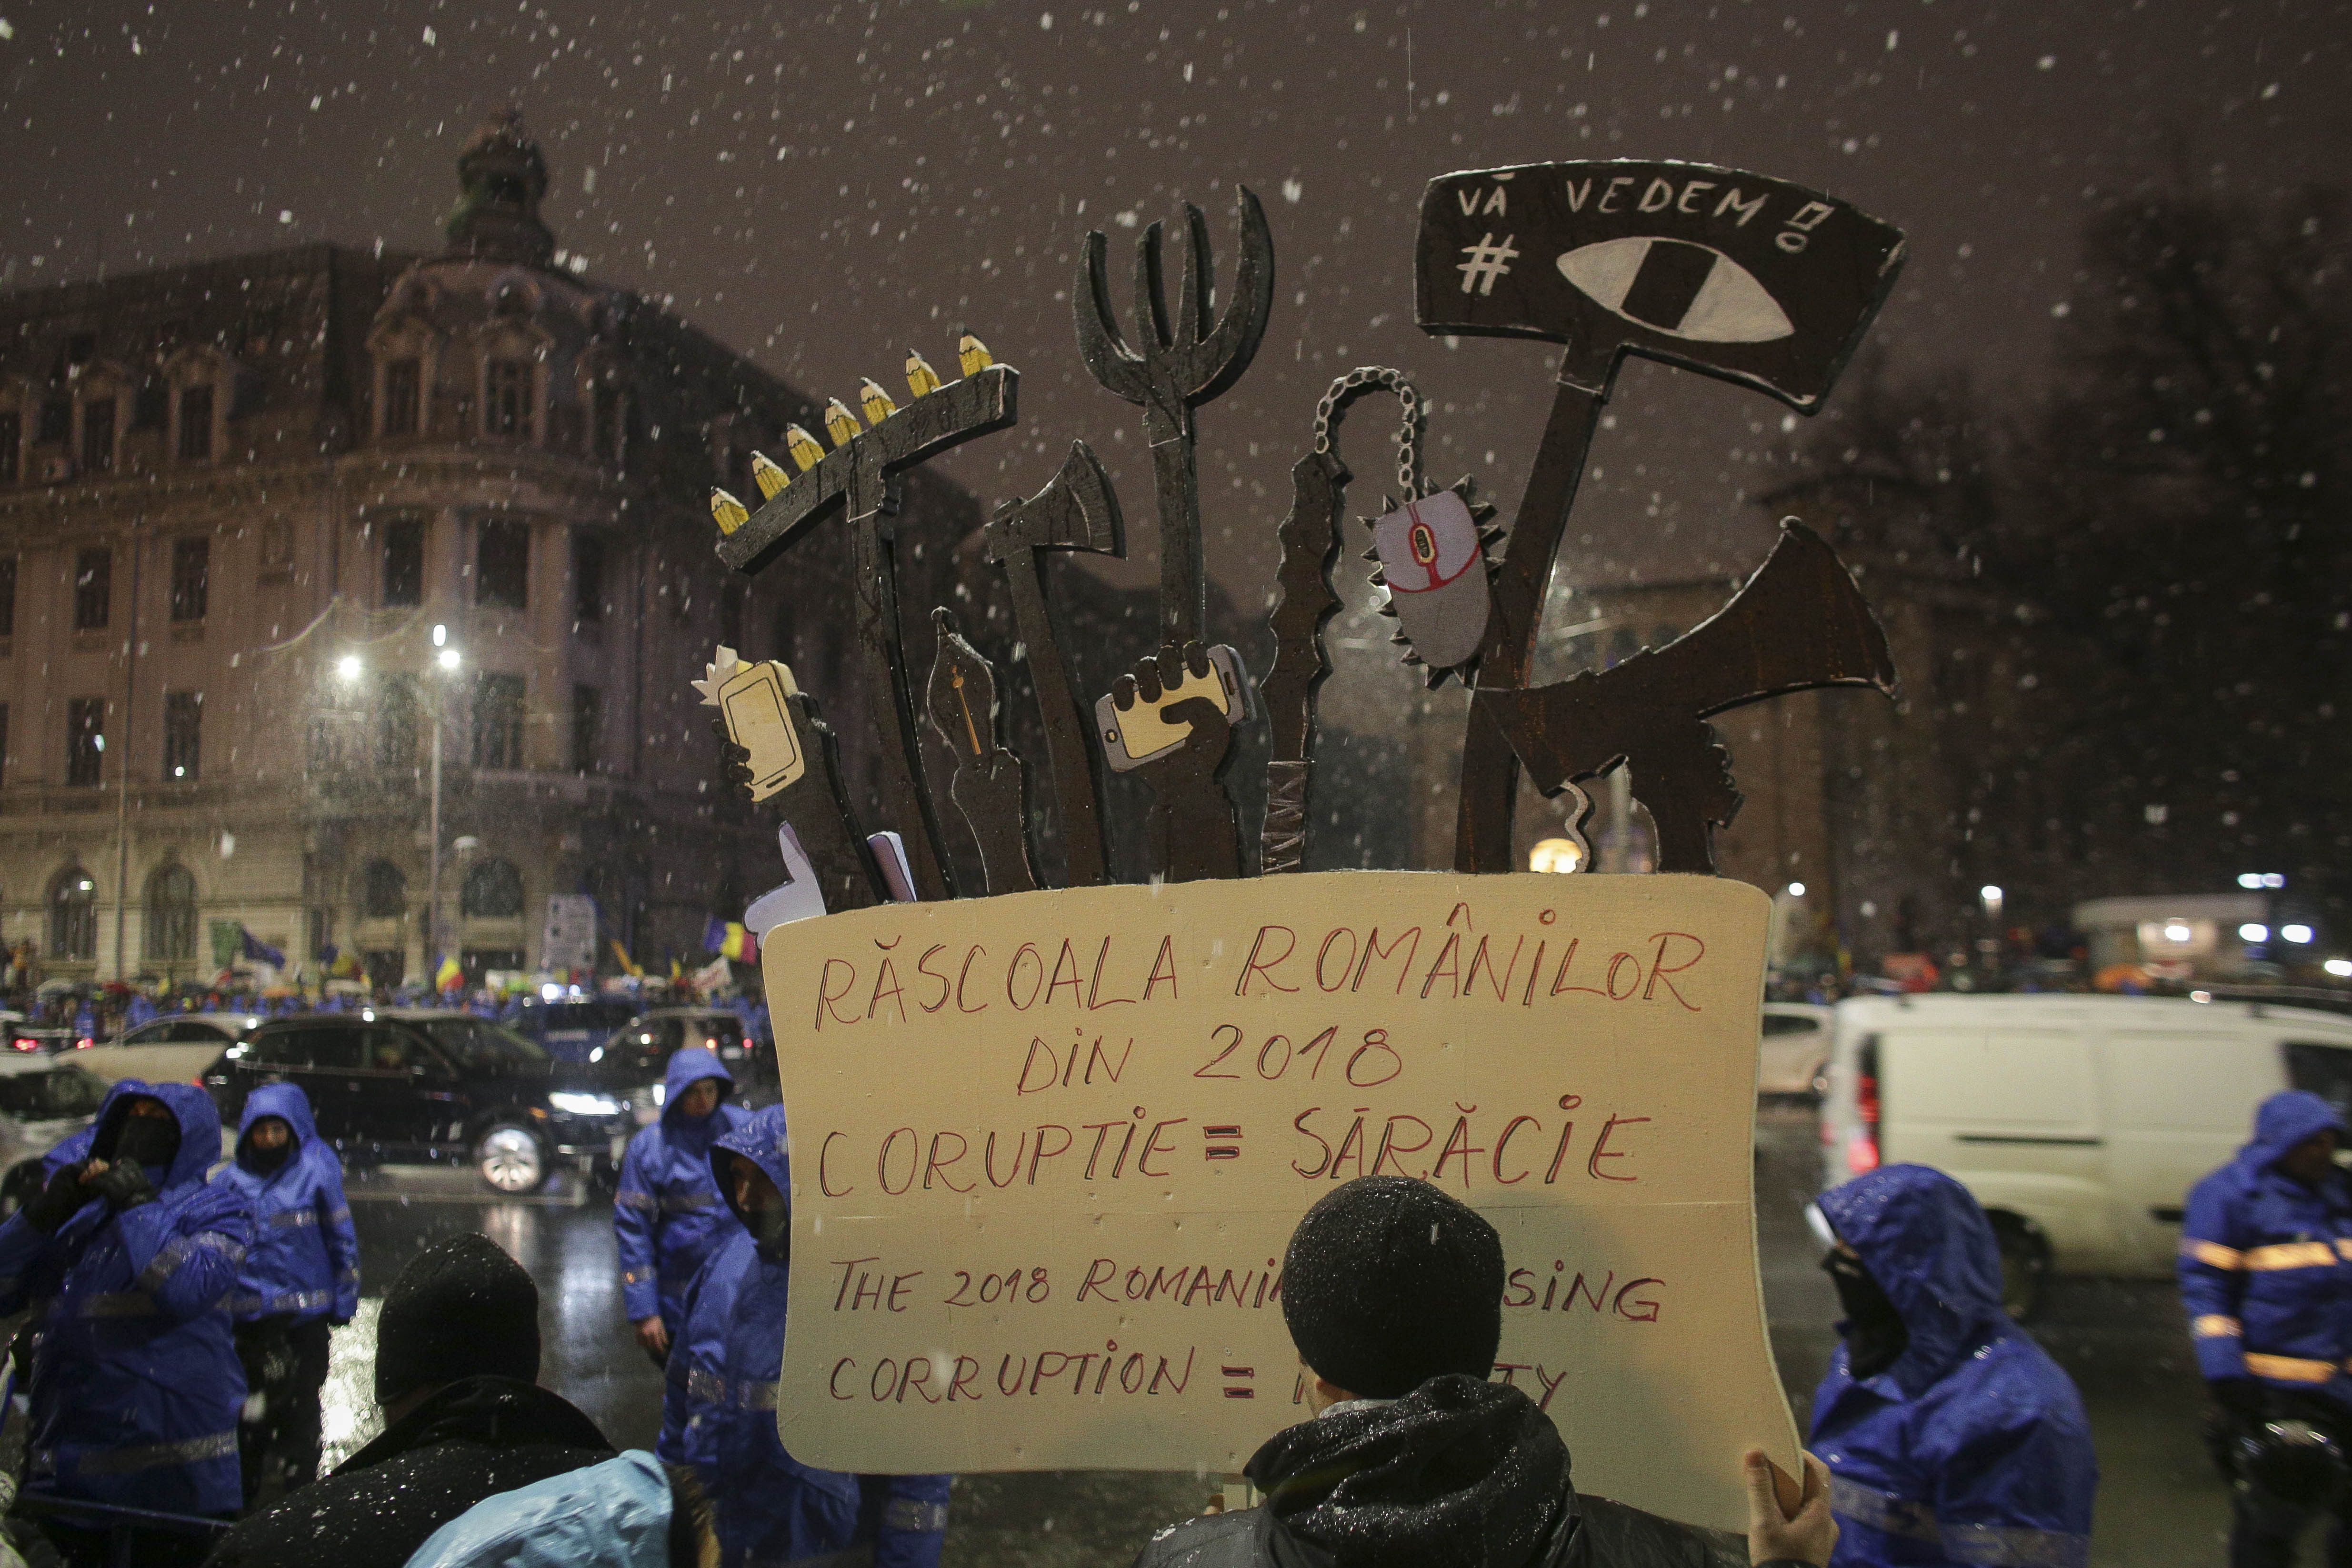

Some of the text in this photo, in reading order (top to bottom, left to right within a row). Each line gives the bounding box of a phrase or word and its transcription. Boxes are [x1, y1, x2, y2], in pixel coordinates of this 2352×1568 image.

[815, 934, 1178, 1032] RĂSCOALA
[1193, 1024, 1401, 1088] 2018
[831, 1256, 924, 1312] THE
[944, 1266, 1050, 1307] 2018
